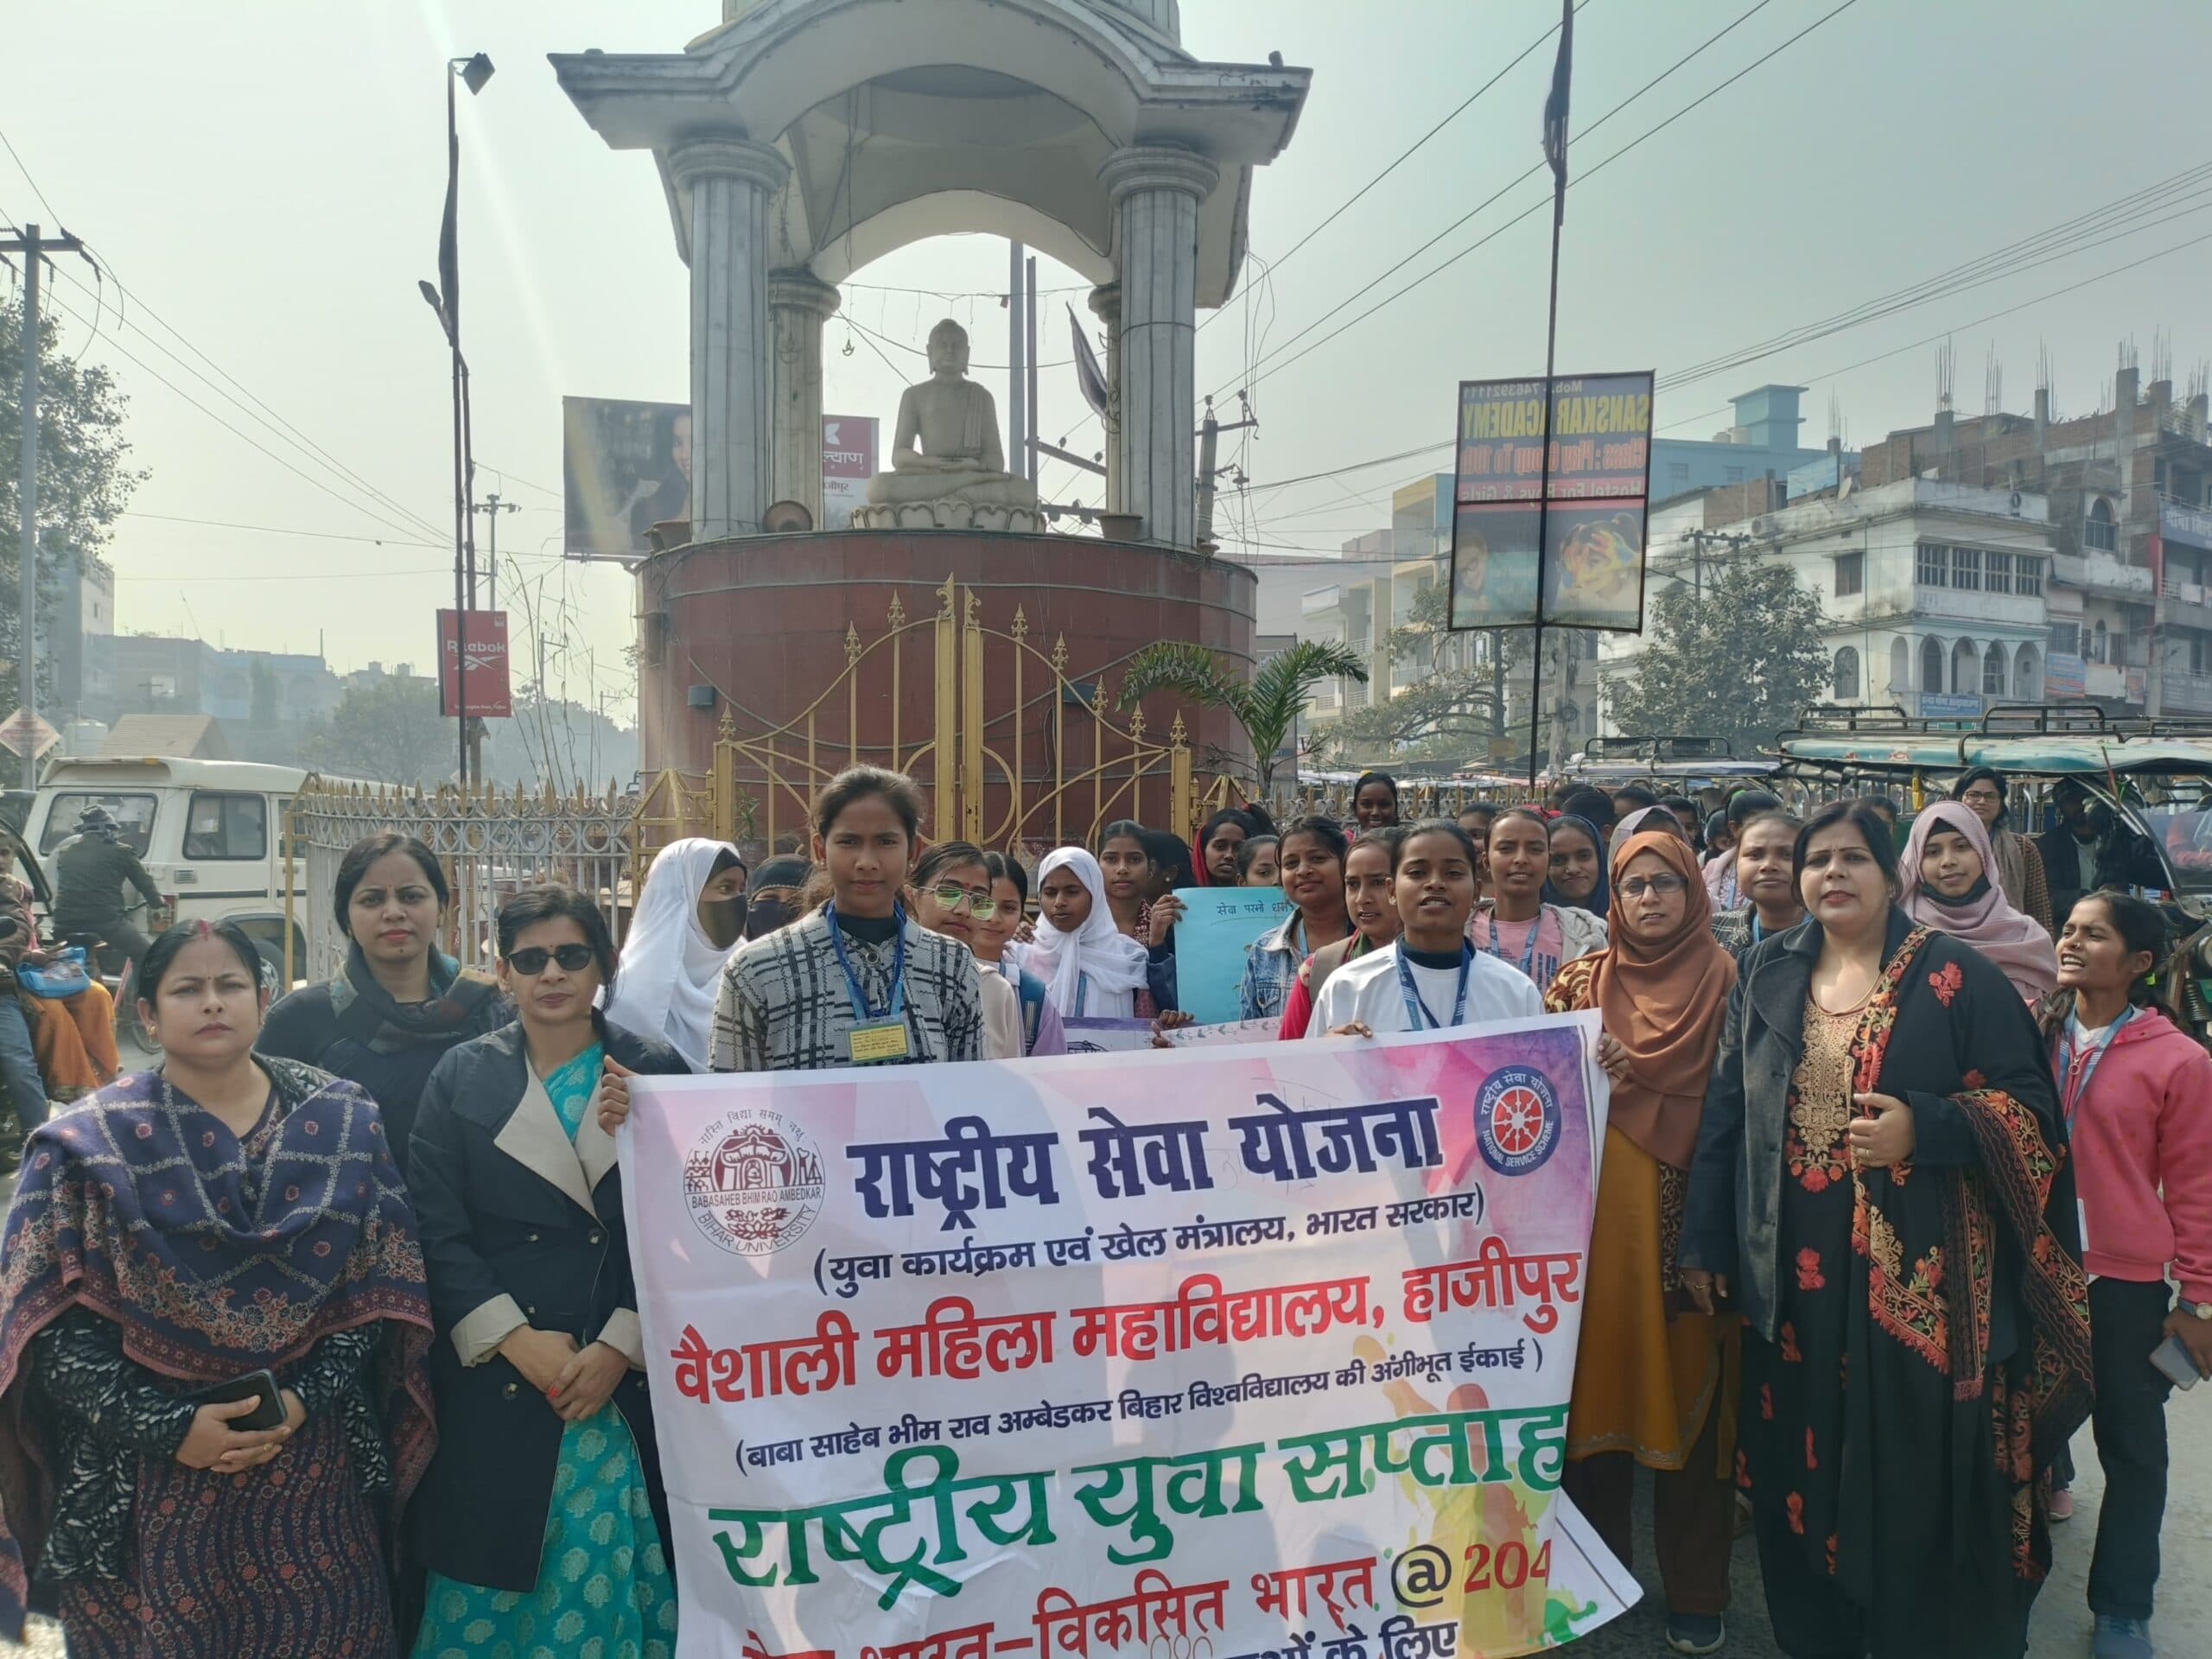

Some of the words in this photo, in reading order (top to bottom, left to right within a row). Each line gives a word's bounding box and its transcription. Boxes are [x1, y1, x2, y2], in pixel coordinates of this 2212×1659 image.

[447, 640, 505, 654] Rebok
[1217, 901, 1236, 915] सेवा
[1503, 1071, 1528, 1086] सेवा
[1530, 1075, 1554, 1108] योजना
[846, 1116, 1058, 1231] राष्ट्रीय
[1078, 1107, 1214, 1198] सेवा
[1228, 1093, 1443, 1181] योजना
[1482, 1129, 1504, 1165] NATIONAL
[1505, 1152, 1537, 1167] SERVICE
[1536, 1120, 1554, 1154] SCHEME
[692, 1192, 741, 1209] BABASAHEB
[741, 1191, 760, 1205] BHIM
[761, 1190, 778, 1204] RAO
[779, 1187, 822, 1202] AMBEDKAR
[698, 1212, 734, 1247] BIHAR
[735, 1203, 817, 1253] UNIVERSITY
[813, 1247, 894, 1299] (युवा
[901, 1236, 1036, 1278] कार्यक्रम
[1044, 1226, 1094, 1267] एवं
[1099, 1222, 1167, 1261] खेल
[1173, 1215, 1295, 1250] मंत्रालय,
[1306, 1207, 1378, 1236] भारत
[1386, 1182, 1484, 1228] सरकार)
[671, 1310, 859, 1404] वैशाली
[874, 1296, 1056, 1379] महिला
[1071, 1274, 1385, 1362] महाविद्यालय,
[1402, 1236, 1583, 1334] हाजीपुर
[734, 1439, 803, 1477] (बाबा
[809, 1421, 880, 1459] साहेब
[888, 1413, 941, 1445] भीम
[948, 1414, 991, 1440] राव
[997, 1399, 1113, 1433] अम्बेडकर
[1117, 1389, 1185, 1421] बिहार
[1187, 1373, 1329, 1410] विश्वविद्यालय
[1336, 1360, 1366, 1386] की
[1371, 1351, 1452, 1383] अंगीभूत
[708, 1445, 1058, 1611] राष्ट्रीय
[1071, 1442, 1266, 1567] युवा
[1278, 1400, 1570, 1504] सप्ताह
[1250, 1556, 1378, 1635] भारत
[1390, 1544, 1452, 1609] @
[1378, 1614, 1459, 1659] लिए
